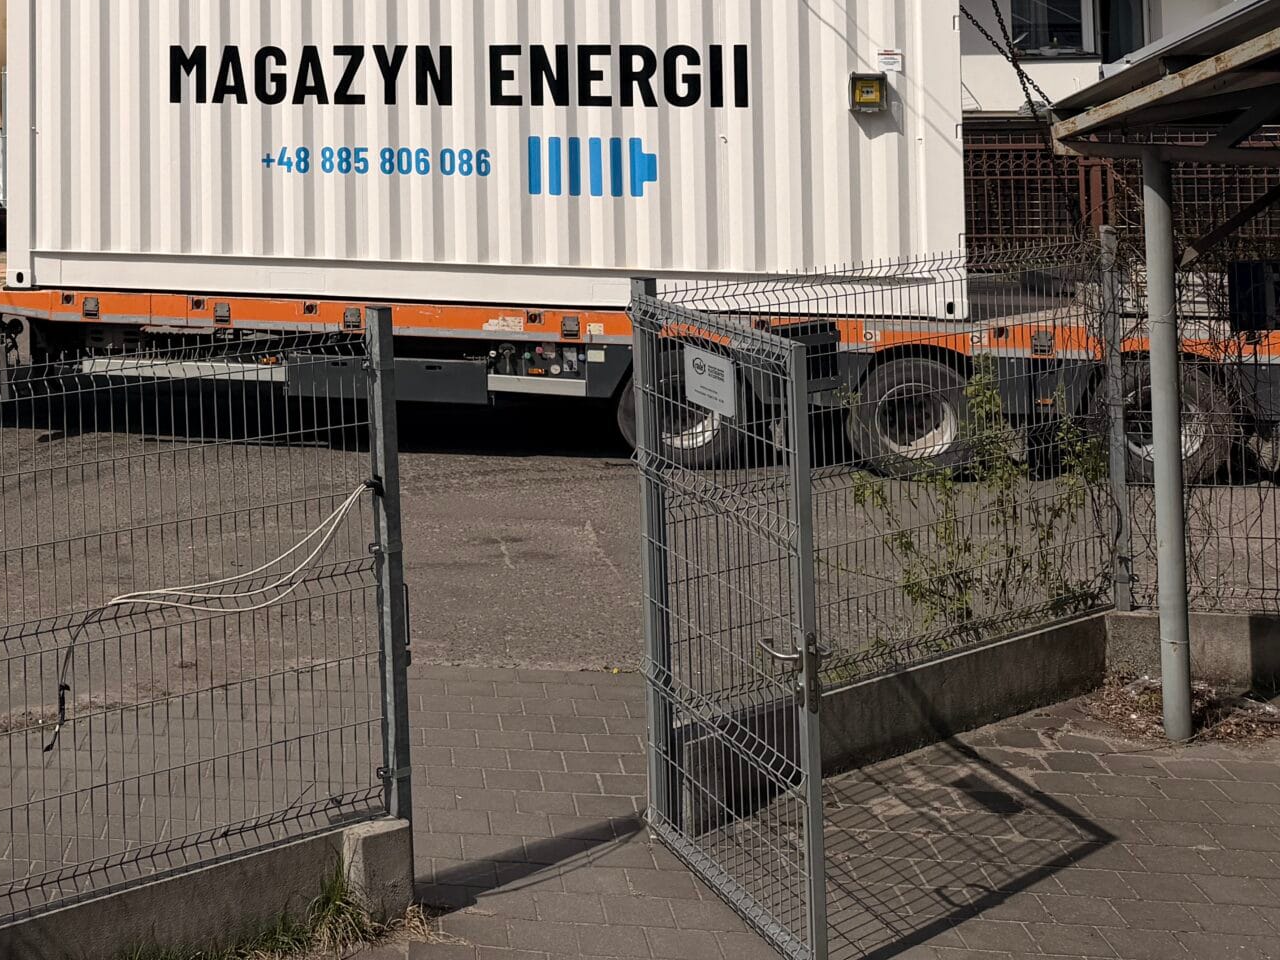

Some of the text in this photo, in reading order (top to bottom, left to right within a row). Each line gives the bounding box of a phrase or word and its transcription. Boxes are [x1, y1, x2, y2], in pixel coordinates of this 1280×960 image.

[168, 43, 749, 108] MAGAZYN ENERGII
[261, 146, 492, 177] +48 885 806 086
